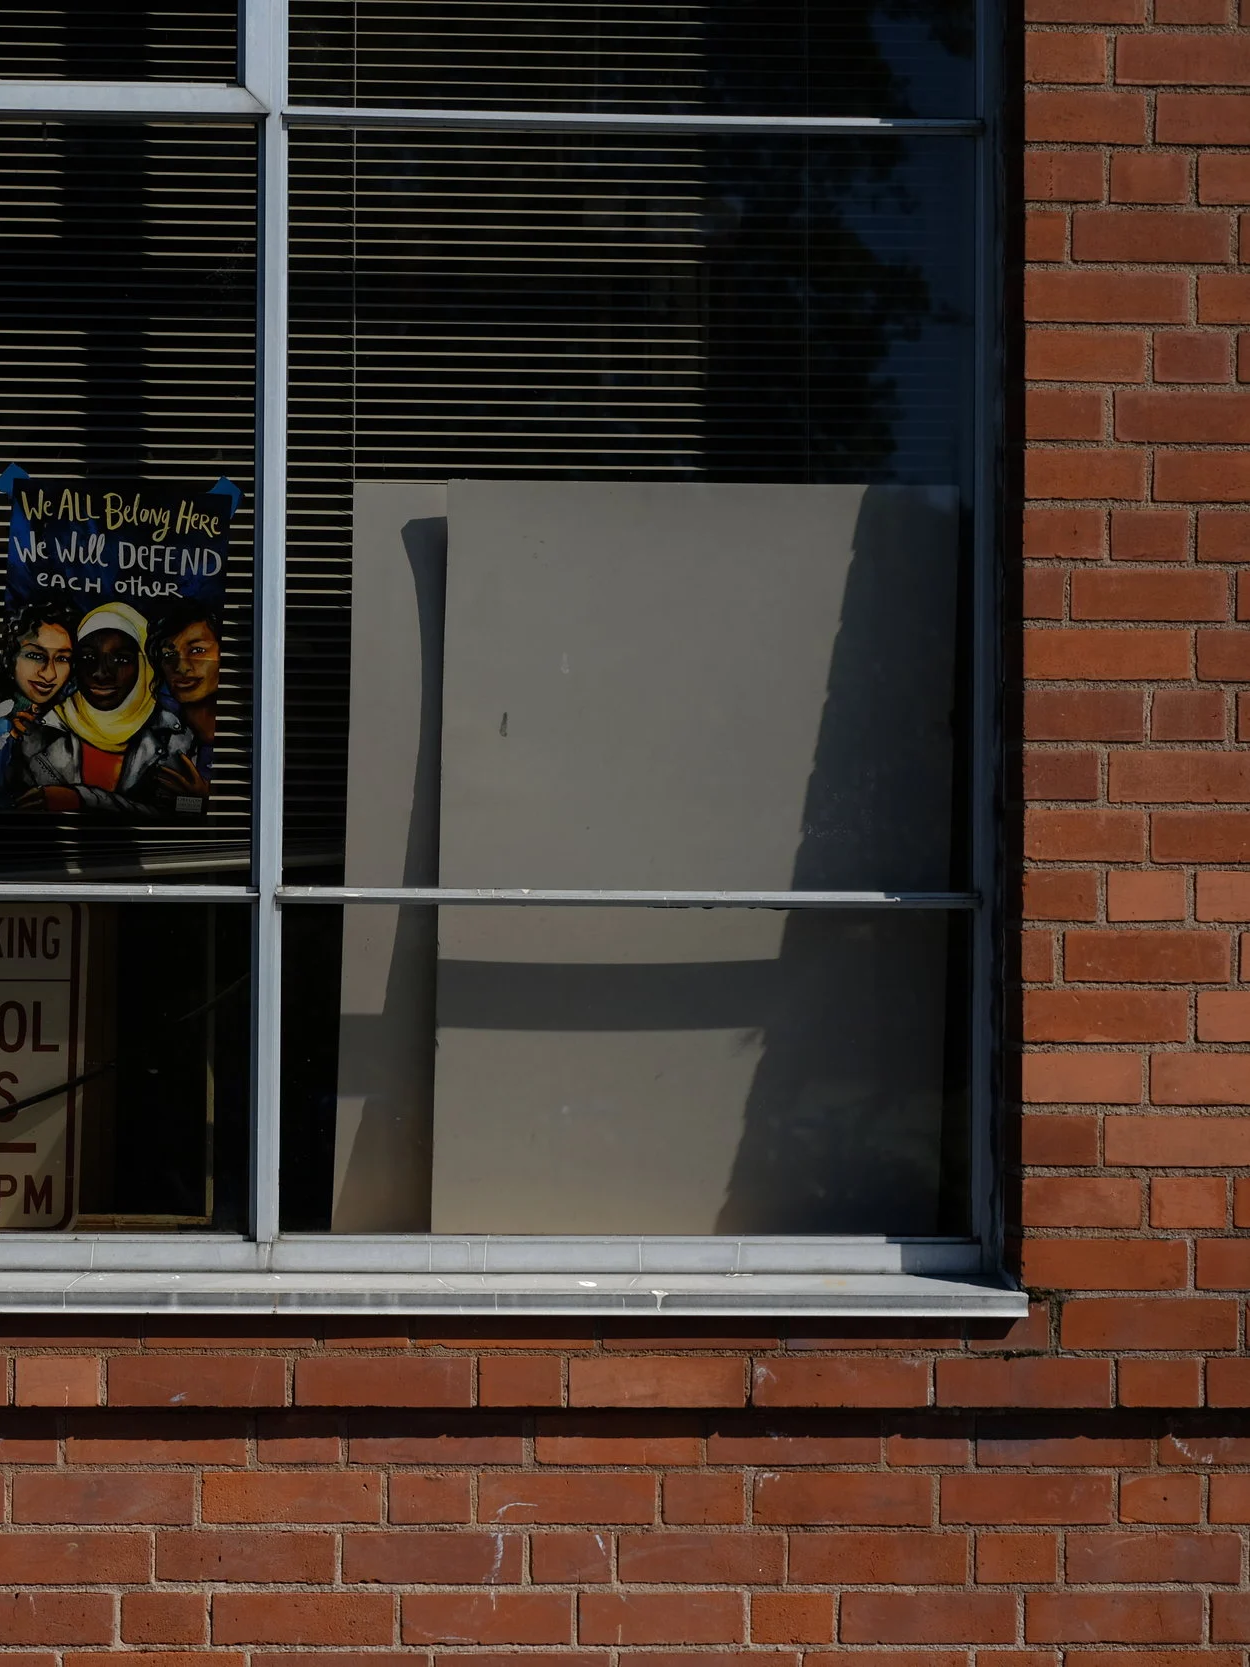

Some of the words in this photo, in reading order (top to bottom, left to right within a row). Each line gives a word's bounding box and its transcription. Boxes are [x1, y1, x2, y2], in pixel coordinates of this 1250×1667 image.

[21, 489, 53, 521] We
[58, 488, 101, 522] ALL
[13, 531, 49, 563] We
[55, 531, 109, 568] Will
